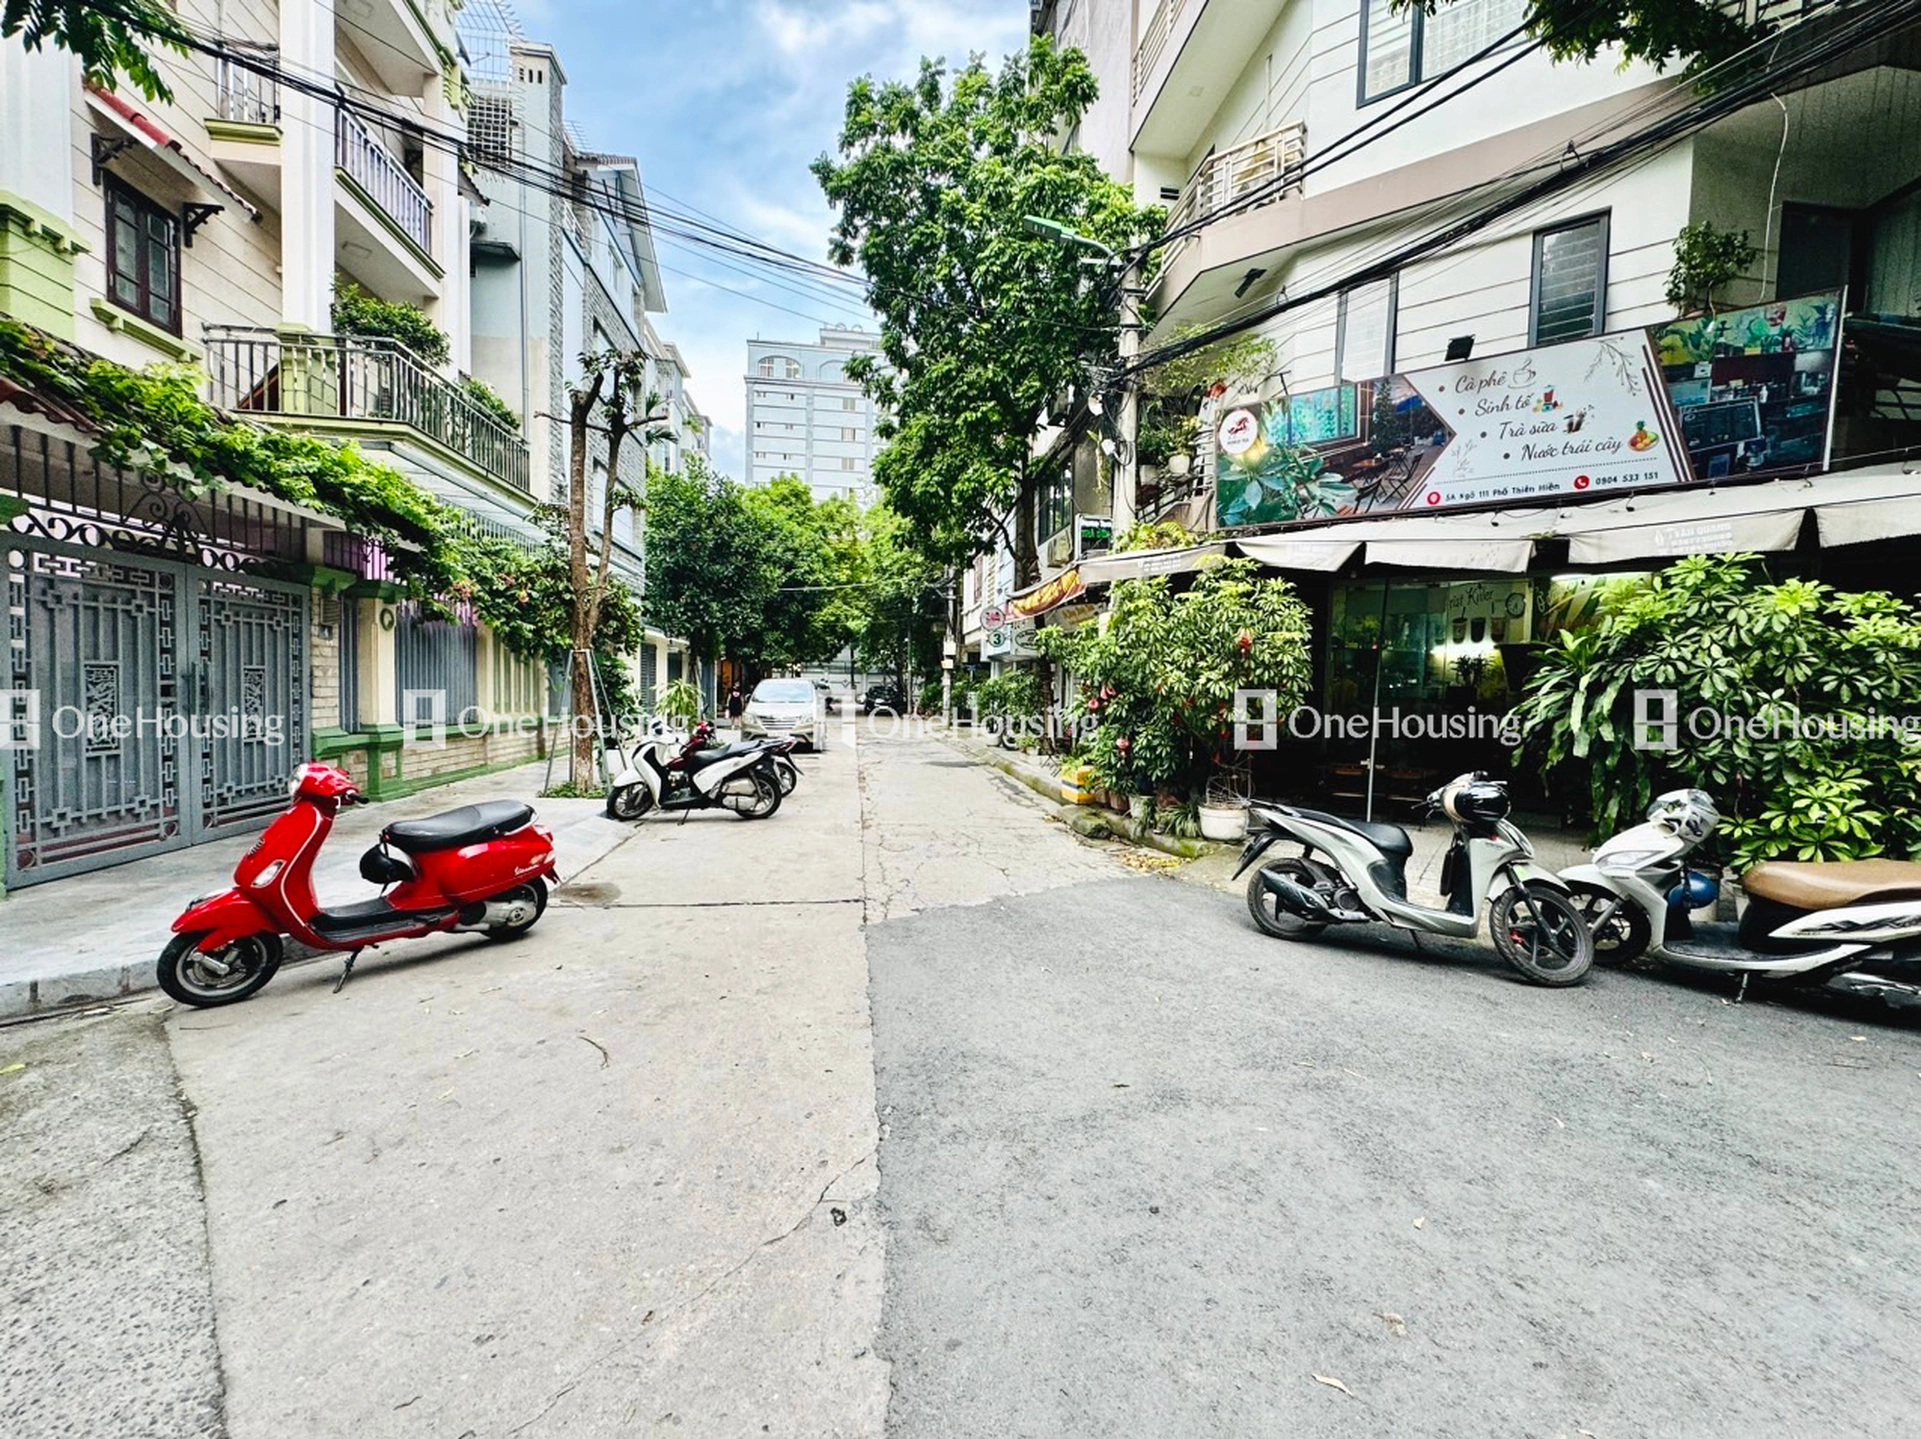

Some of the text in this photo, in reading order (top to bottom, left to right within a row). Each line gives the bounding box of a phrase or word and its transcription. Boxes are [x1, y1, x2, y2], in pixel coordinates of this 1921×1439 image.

[1455, 370, 1507, 395] Cà phê
[1474, 393, 1535, 417] Sinh tố
[1499, 421, 1526, 440] Trà
[1521, 436, 1623, 461] Nước trái cây
[1644, 471, 1659, 481] 151
[993, 633, 1002, 645] 3
